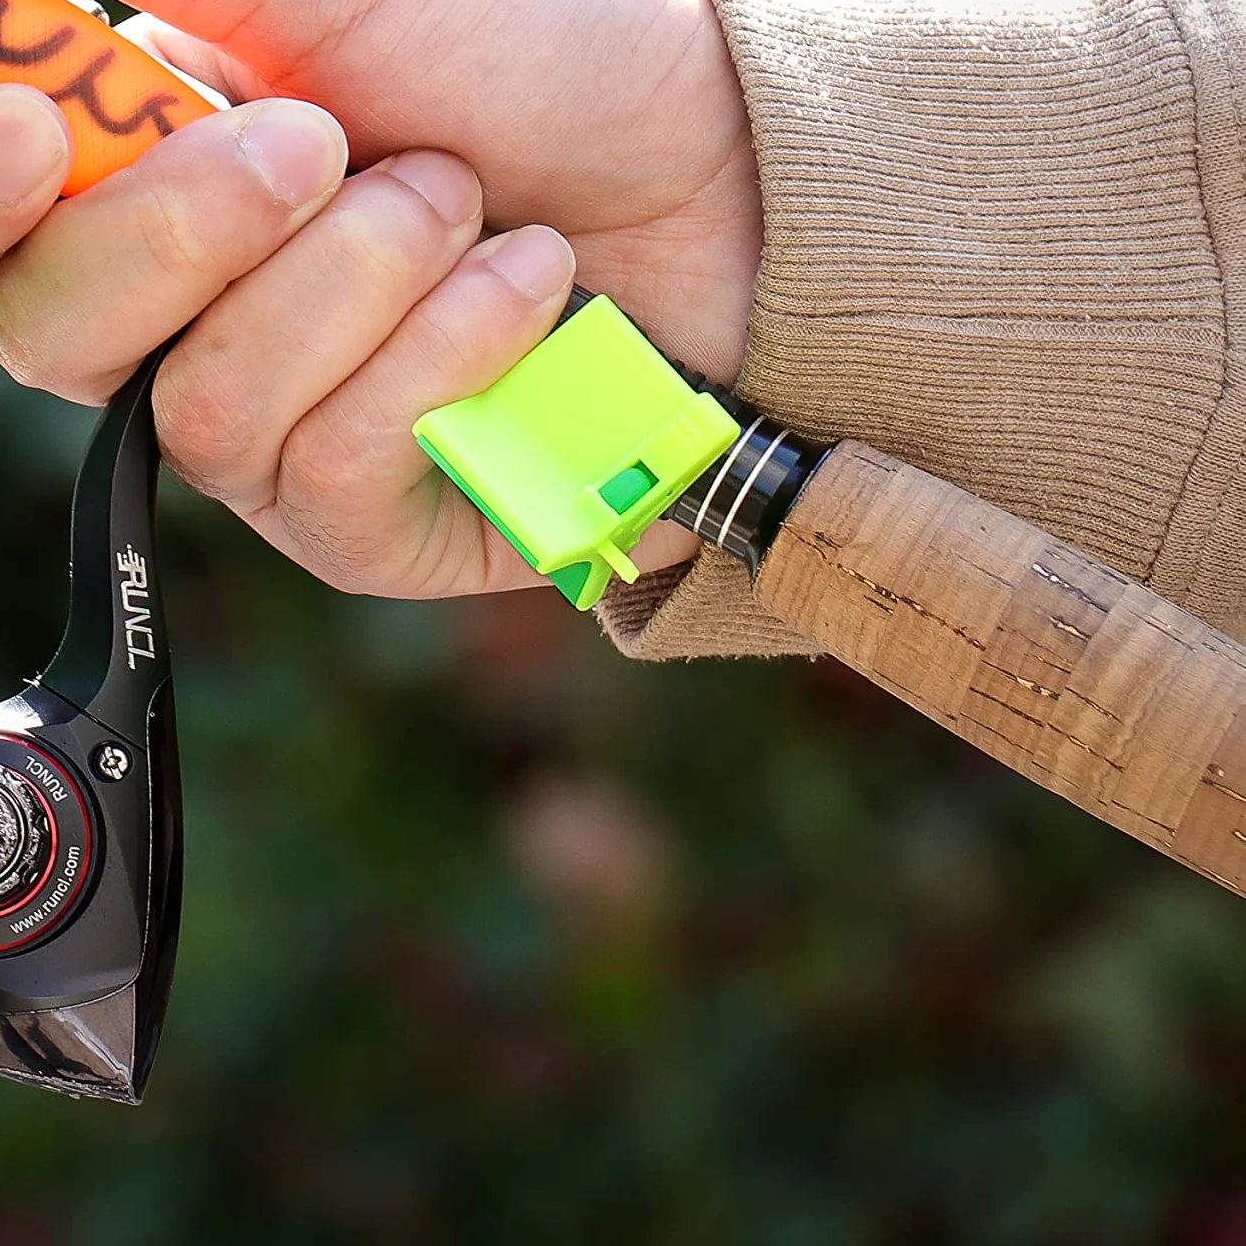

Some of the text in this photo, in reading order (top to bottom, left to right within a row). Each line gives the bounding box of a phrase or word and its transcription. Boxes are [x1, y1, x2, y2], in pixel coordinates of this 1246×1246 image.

[116, 543, 156, 671] RUNCL
[25, 755, 69, 803] RUNCL
[9, 845, 81, 935] www.runcl.com
